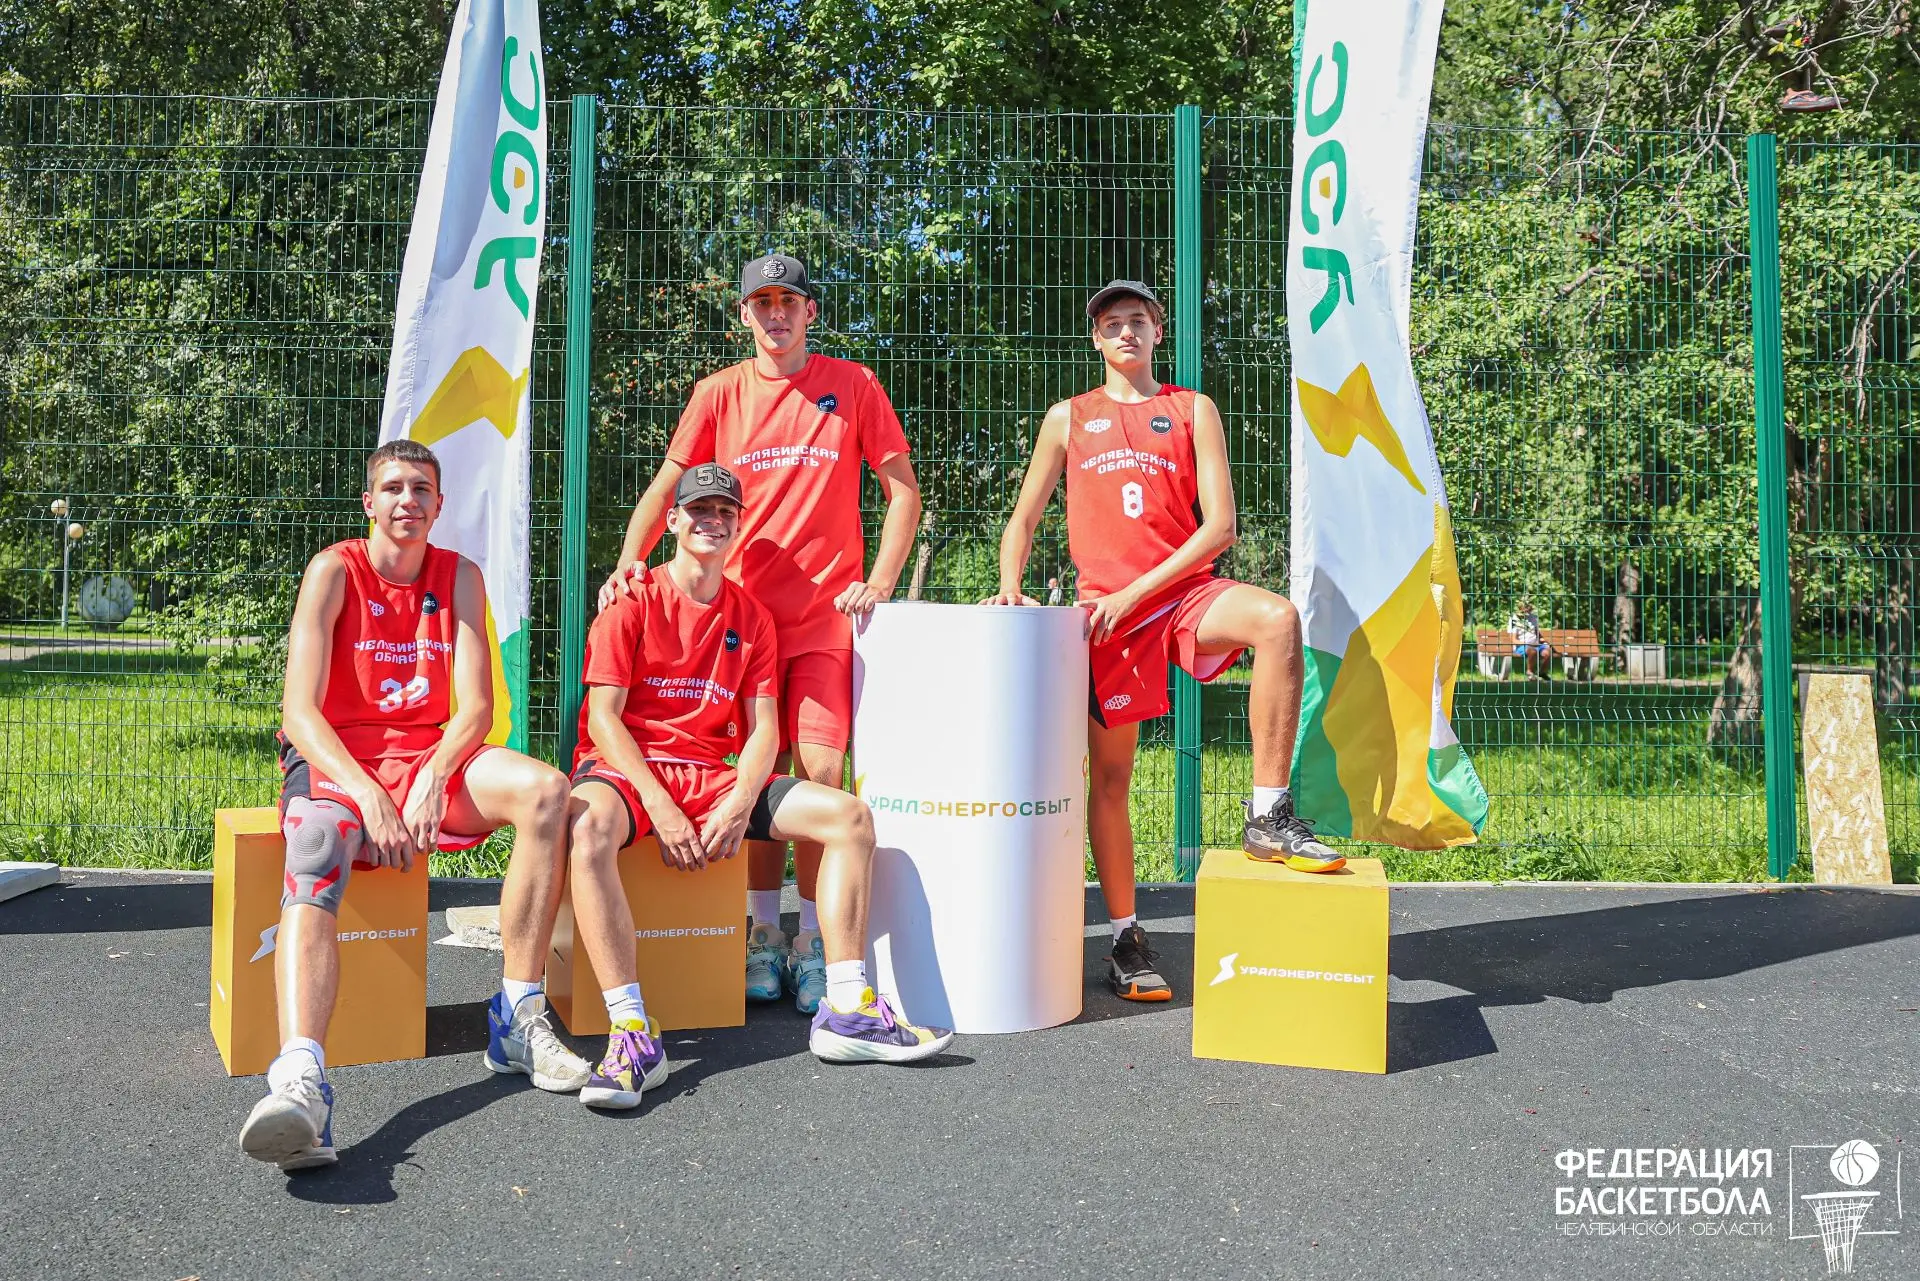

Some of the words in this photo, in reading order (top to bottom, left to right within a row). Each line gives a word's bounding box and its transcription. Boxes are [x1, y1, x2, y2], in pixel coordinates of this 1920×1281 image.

[733, 445, 839, 465] ЧЕЛЯБИНСКАЯ
[752, 456, 820, 472] ОБЛАСТЬ
[1121, 481, 1144, 519] 8
[374, 650, 435, 665] ОБЛАСТЬ
[378, 675, 430, 713] 32
[643, 676, 736, 702] ЧЕЛЯБИНСКАЯ
[657, 688, 719, 705] ОБЛАСТЬ
[869, 795, 1071, 817] УРАЛЭНЕРГОСБЫТ
[1239, 965, 1376, 985] УРАЛЭНЕРГОСБЫТ
